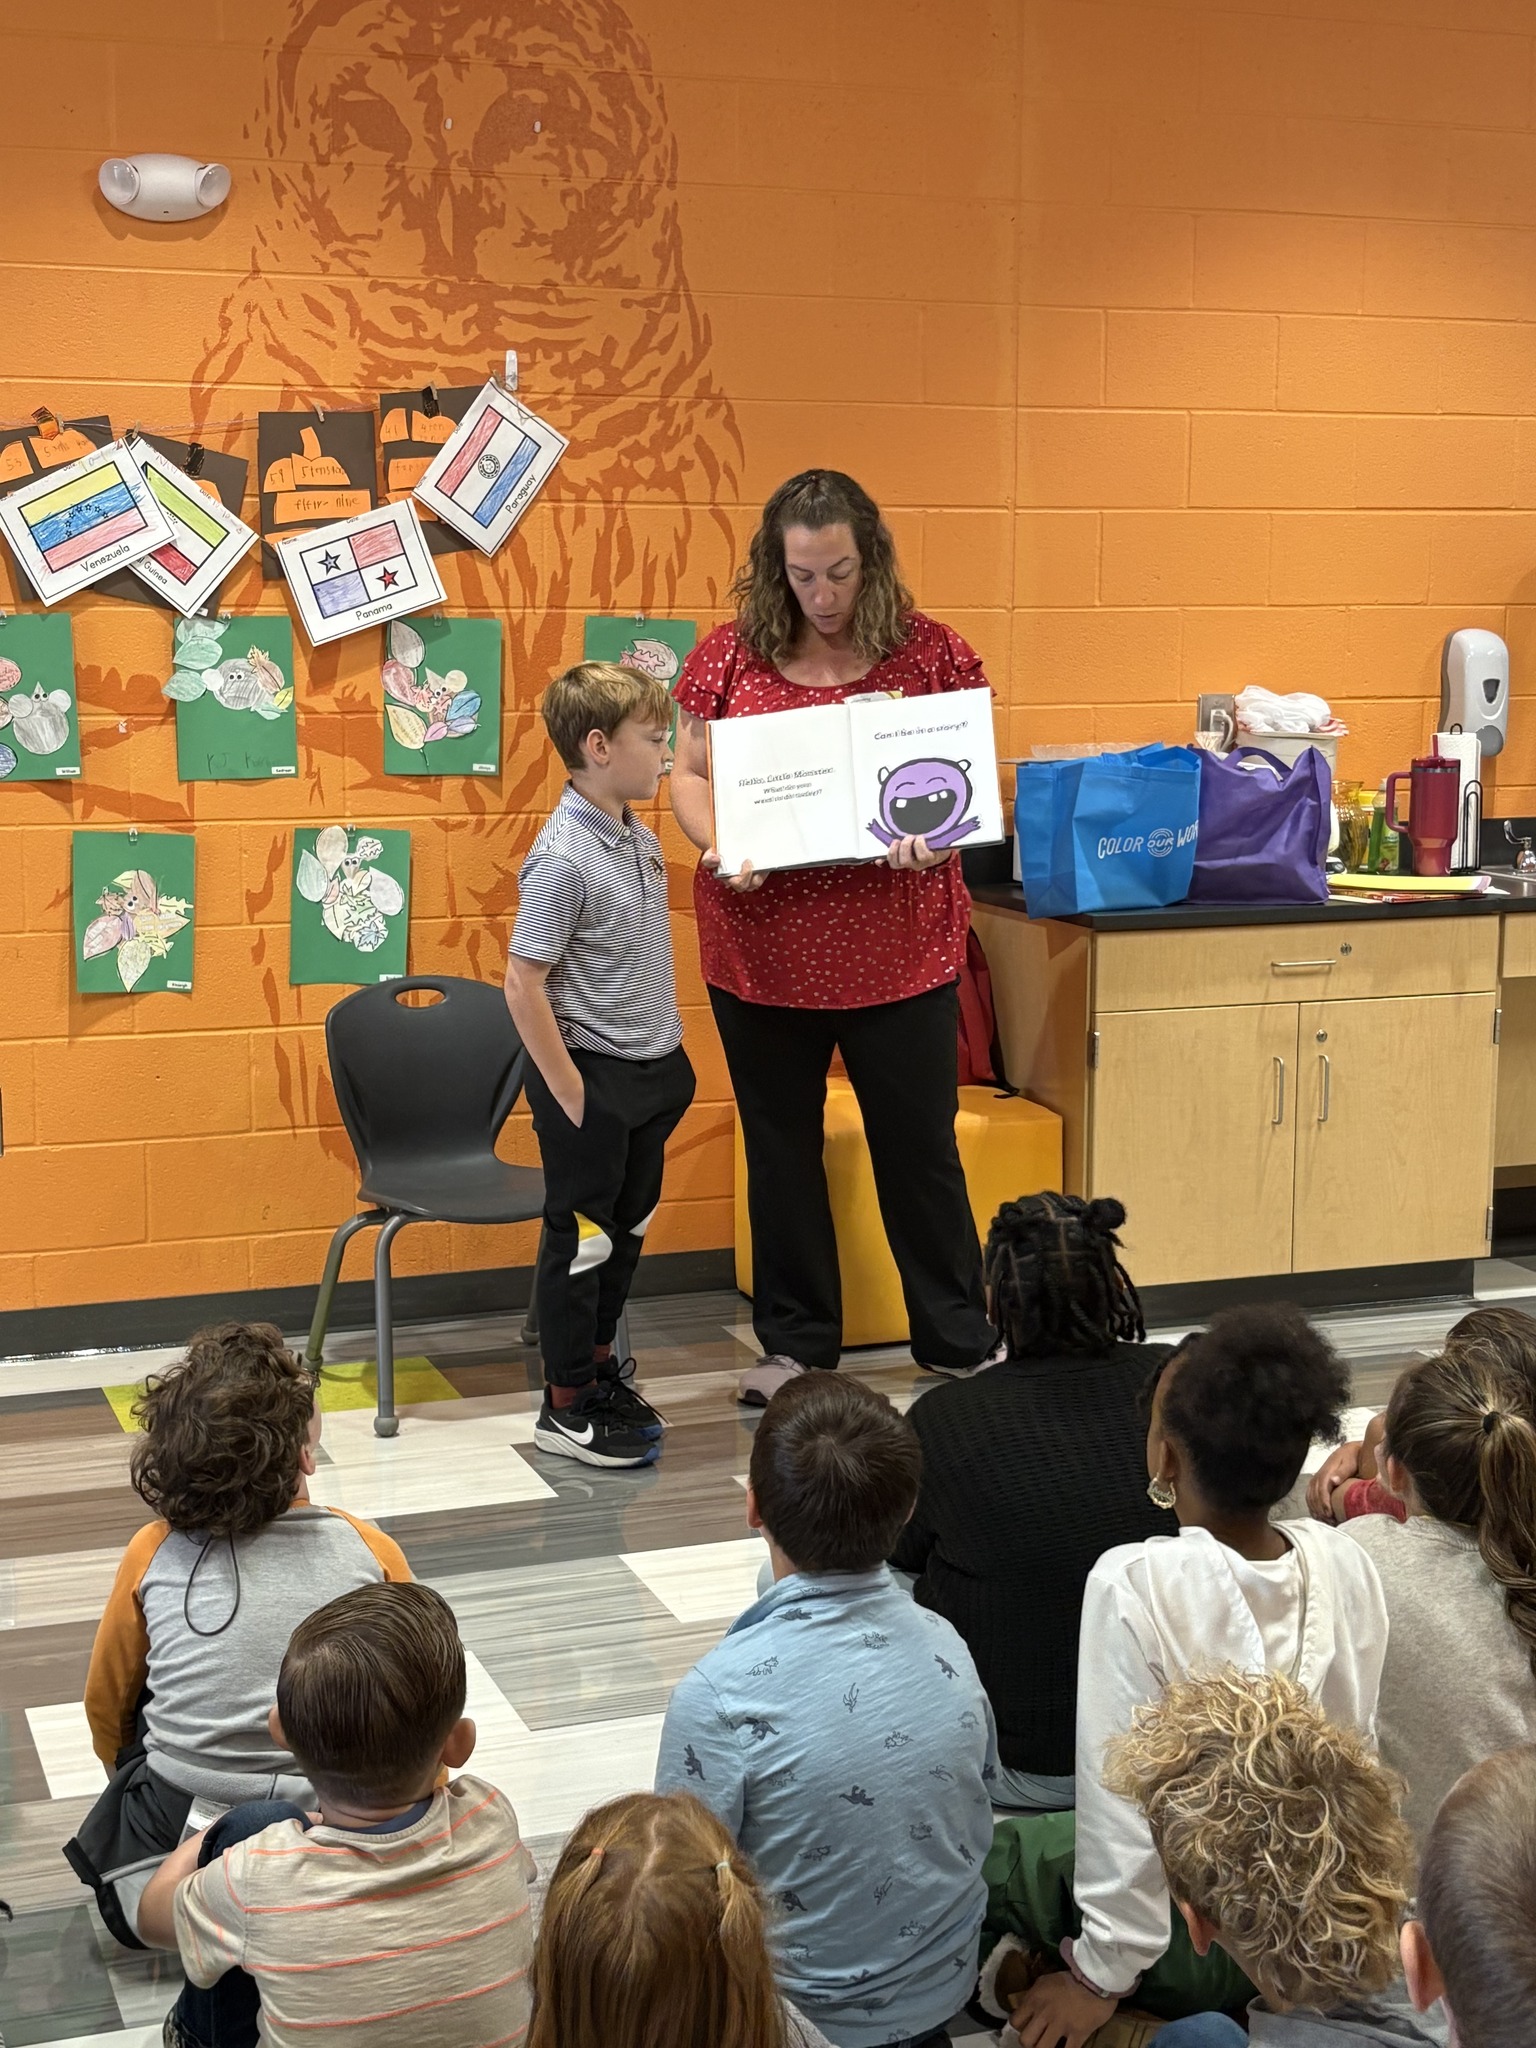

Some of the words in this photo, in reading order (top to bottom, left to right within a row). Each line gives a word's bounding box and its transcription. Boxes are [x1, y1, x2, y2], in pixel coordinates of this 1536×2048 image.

[505, 474, 537, 514] Paraguay
[80, 545, 130, 572] Venezuela
[143, 561, 168, 585] Guinea
[355, 603, 393, 621] Panama
[874, 731, 894, 740] Can
[1097, 836, 1144, 859] COLOR
[1147, 837, 1175, 848] OUR
